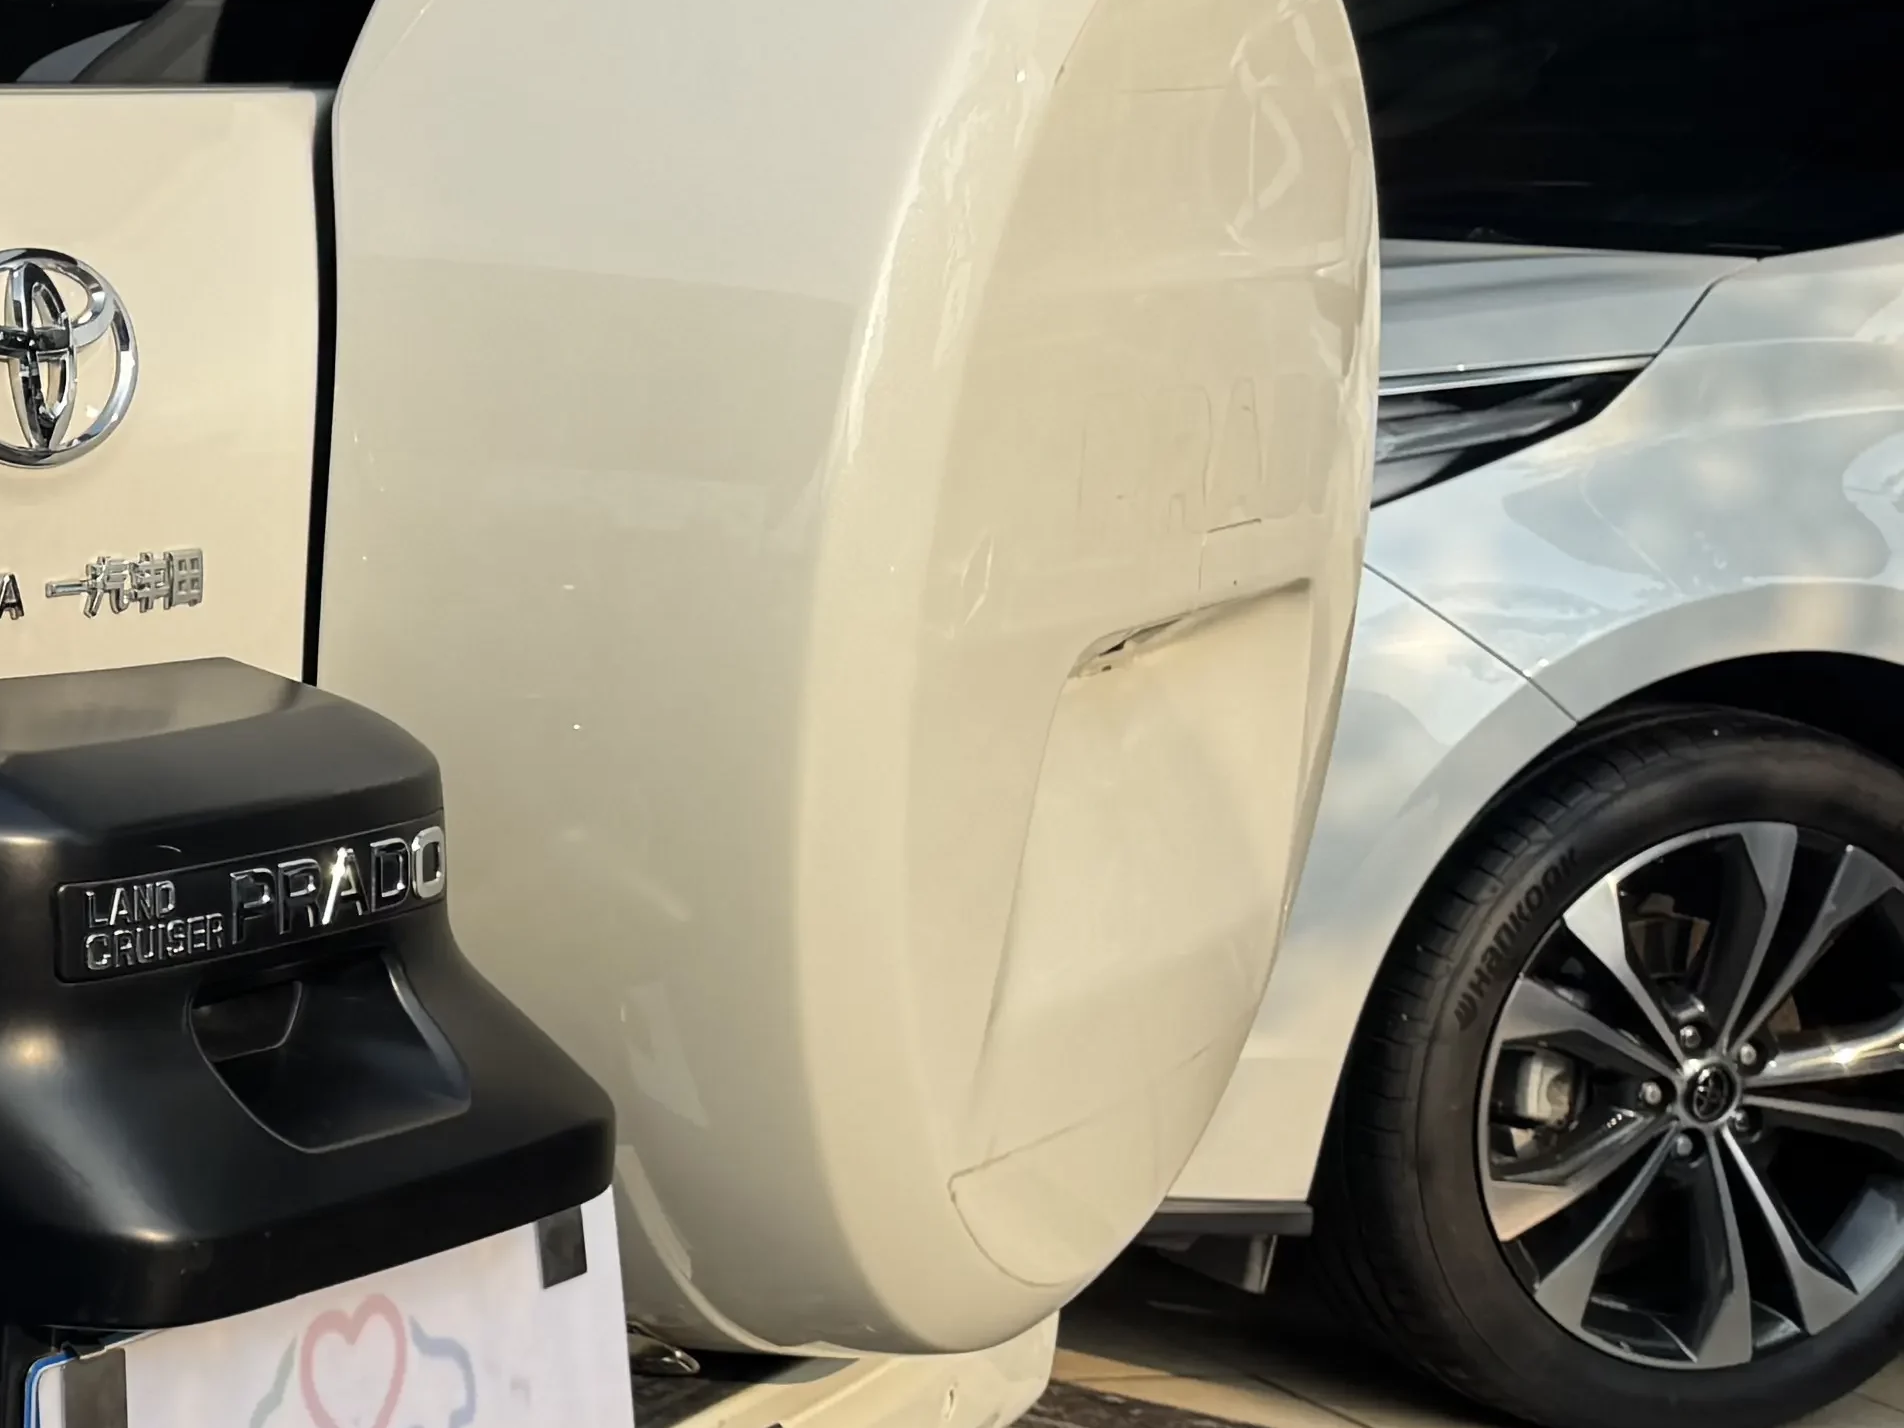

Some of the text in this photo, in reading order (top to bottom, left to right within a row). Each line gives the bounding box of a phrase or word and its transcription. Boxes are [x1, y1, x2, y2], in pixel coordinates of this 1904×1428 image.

[82, 876, 178, 926] LAND
[228, 823, 448, 946] PRADO
[83, 912, 225, 973] CRUISER
